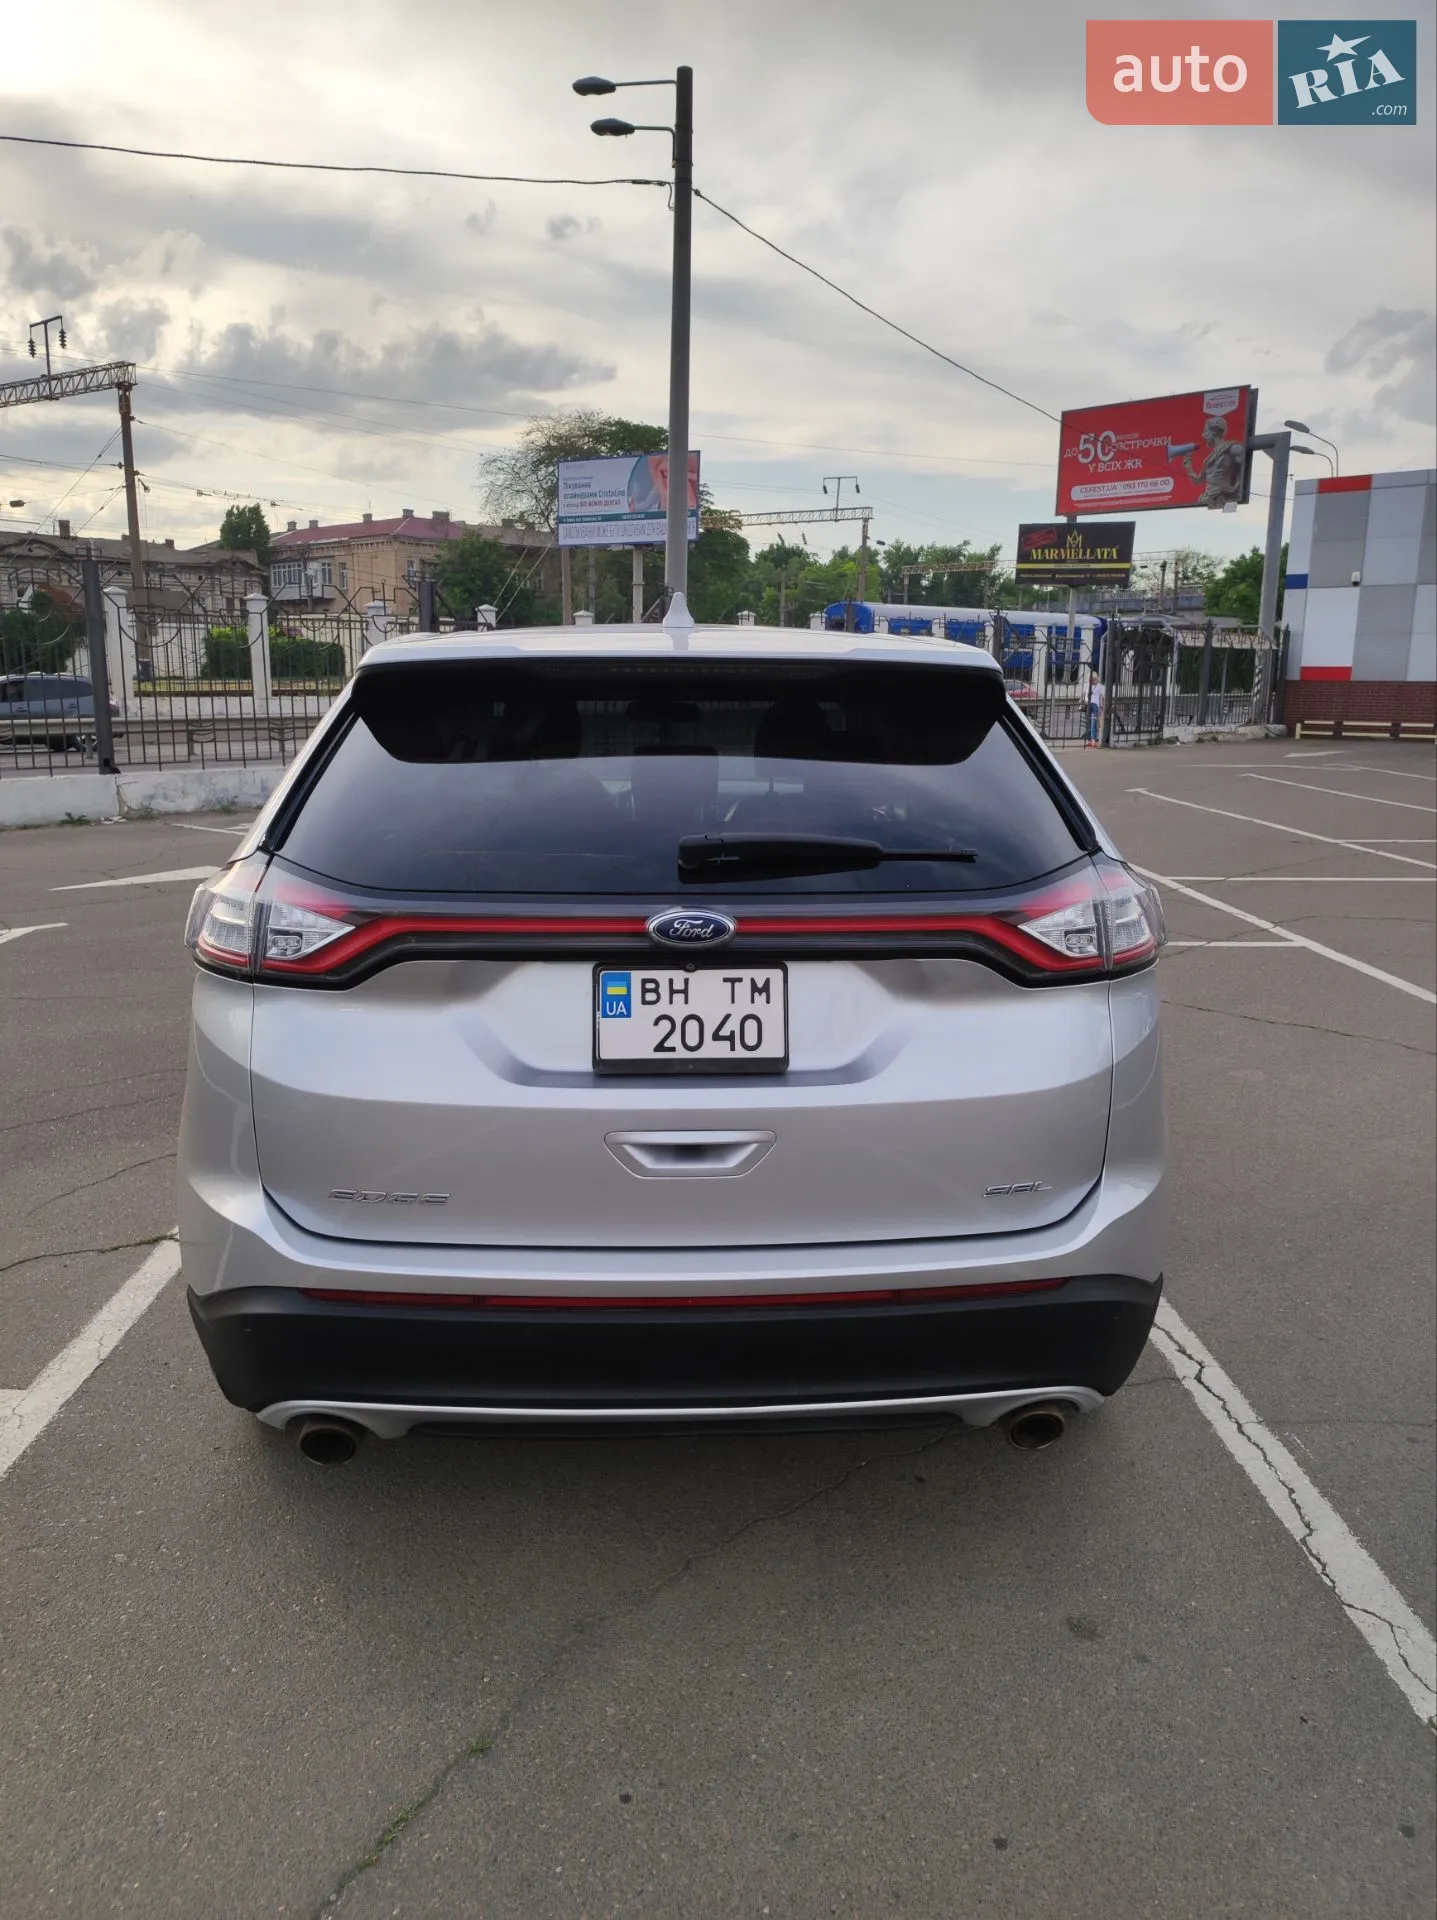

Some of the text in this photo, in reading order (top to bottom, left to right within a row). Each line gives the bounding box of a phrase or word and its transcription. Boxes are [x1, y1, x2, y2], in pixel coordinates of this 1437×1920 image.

[1064, 430, 1117, 464] ДО 50
[1097, 460, 1124, 472] ВСІХ
[1124, 458, 1143, 470] ЖК
[1030, 547, 1119, 560] MARMELLATA
[669, 918, 715, 938] Ford
[640, 976, 771, 1006] BH TM
[605, 1001, 627, 1016] UA
[653, 1013, 763, 1053] 2040
[329, 1188, 450, 1205] EDGE
